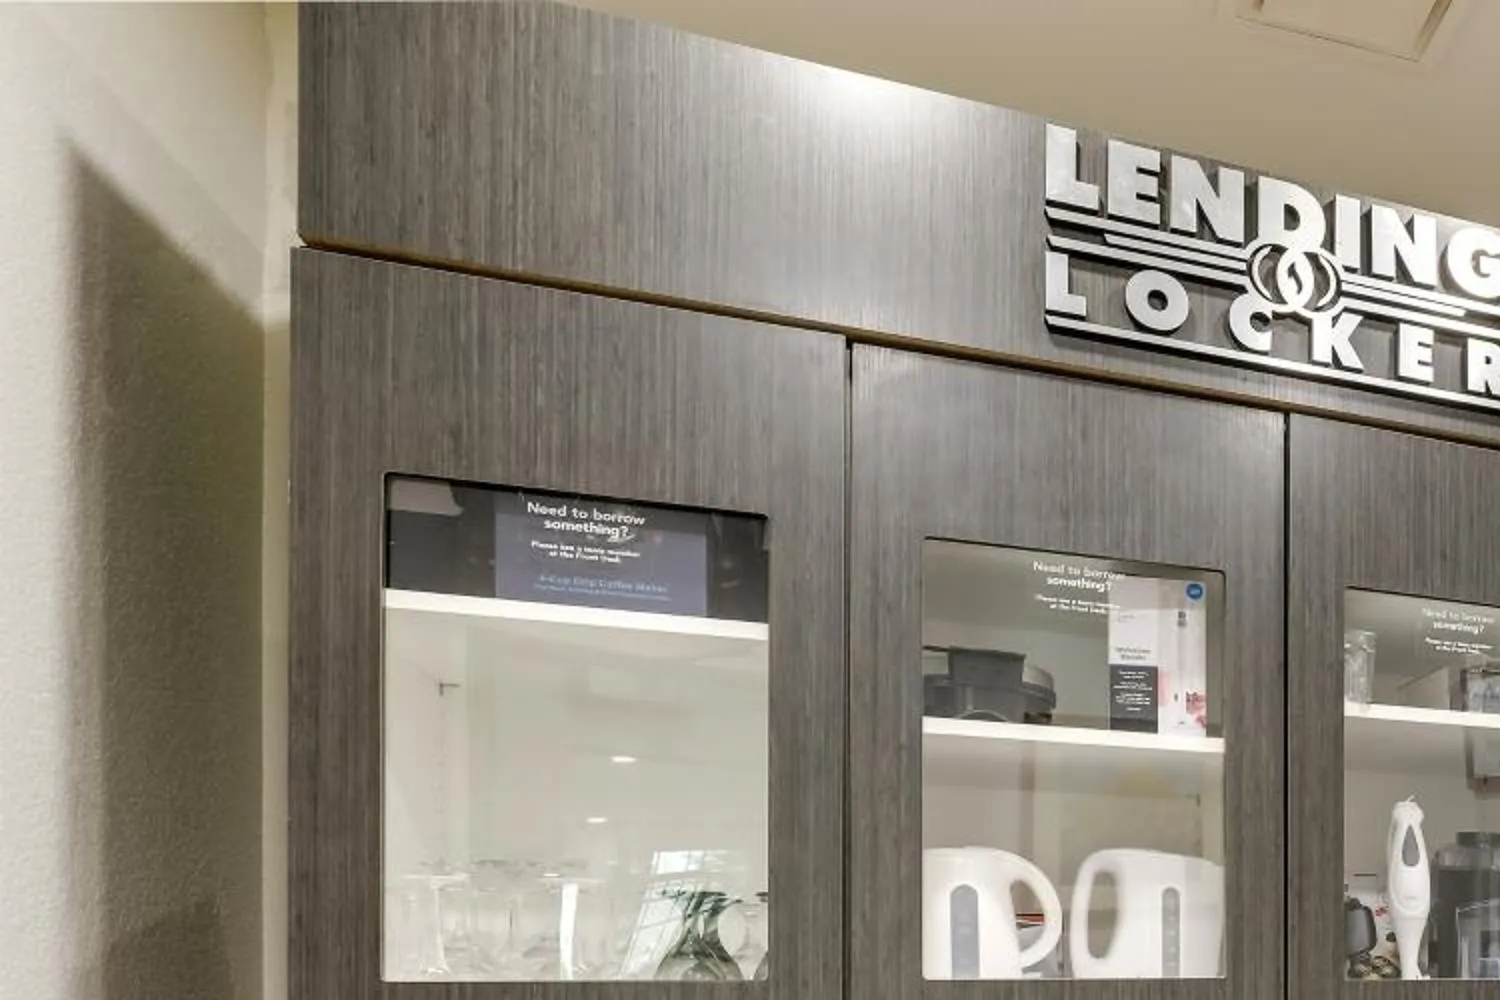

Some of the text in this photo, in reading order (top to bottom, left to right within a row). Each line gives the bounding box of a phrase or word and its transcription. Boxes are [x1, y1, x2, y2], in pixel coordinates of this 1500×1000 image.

[527, 502, 646, 525] Need to borrow
[544, 519, 629, 538] something?
